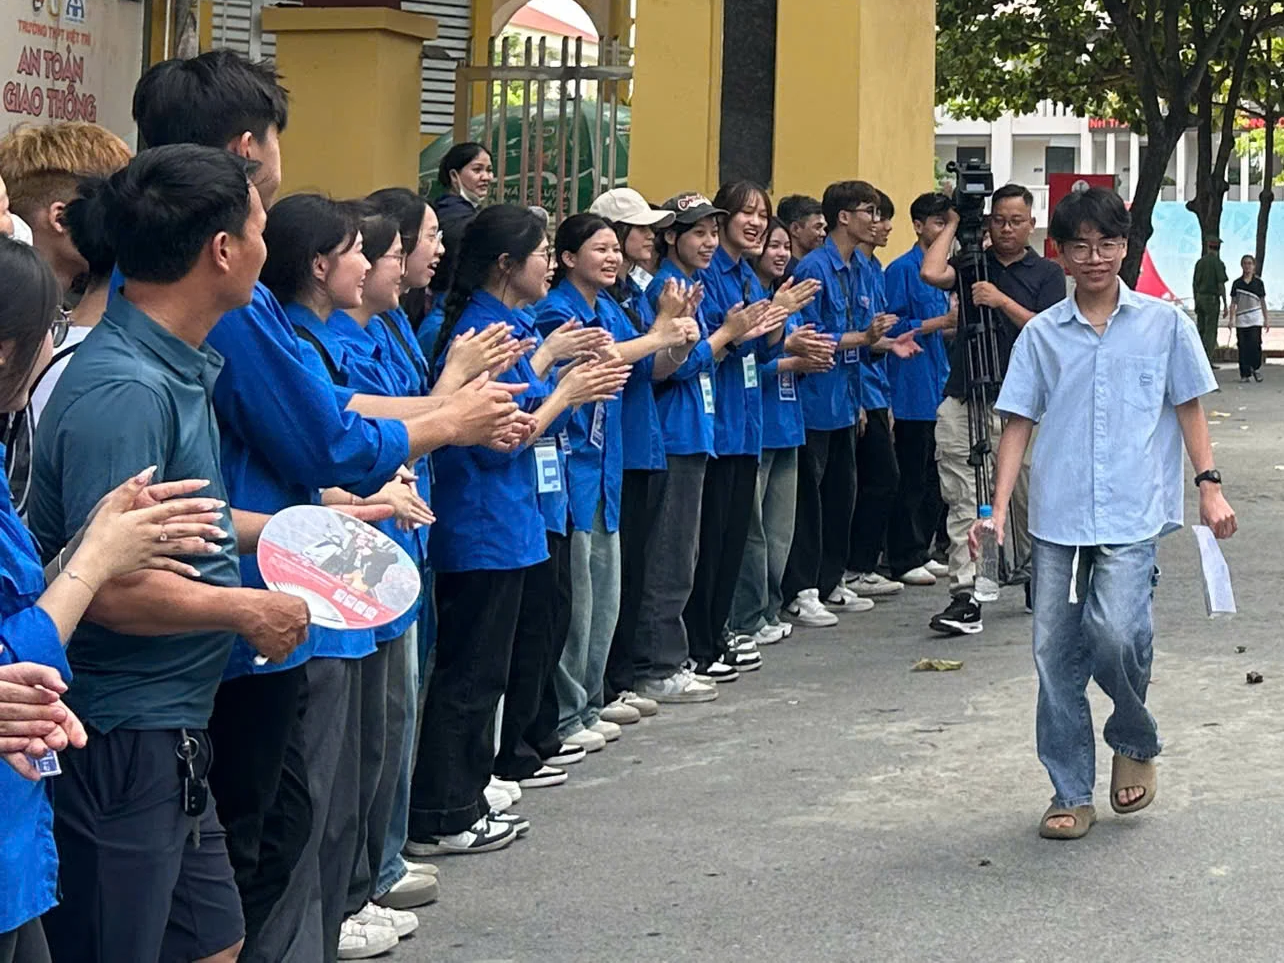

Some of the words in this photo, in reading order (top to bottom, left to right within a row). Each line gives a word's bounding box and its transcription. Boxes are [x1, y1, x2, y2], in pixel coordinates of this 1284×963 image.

[17, 45, 41, 77] AN
[43, 44, 84, 84] TOÀN
[3, 81, 44, 117] GIAO
[46, 81, 97, 123] THÔNG
